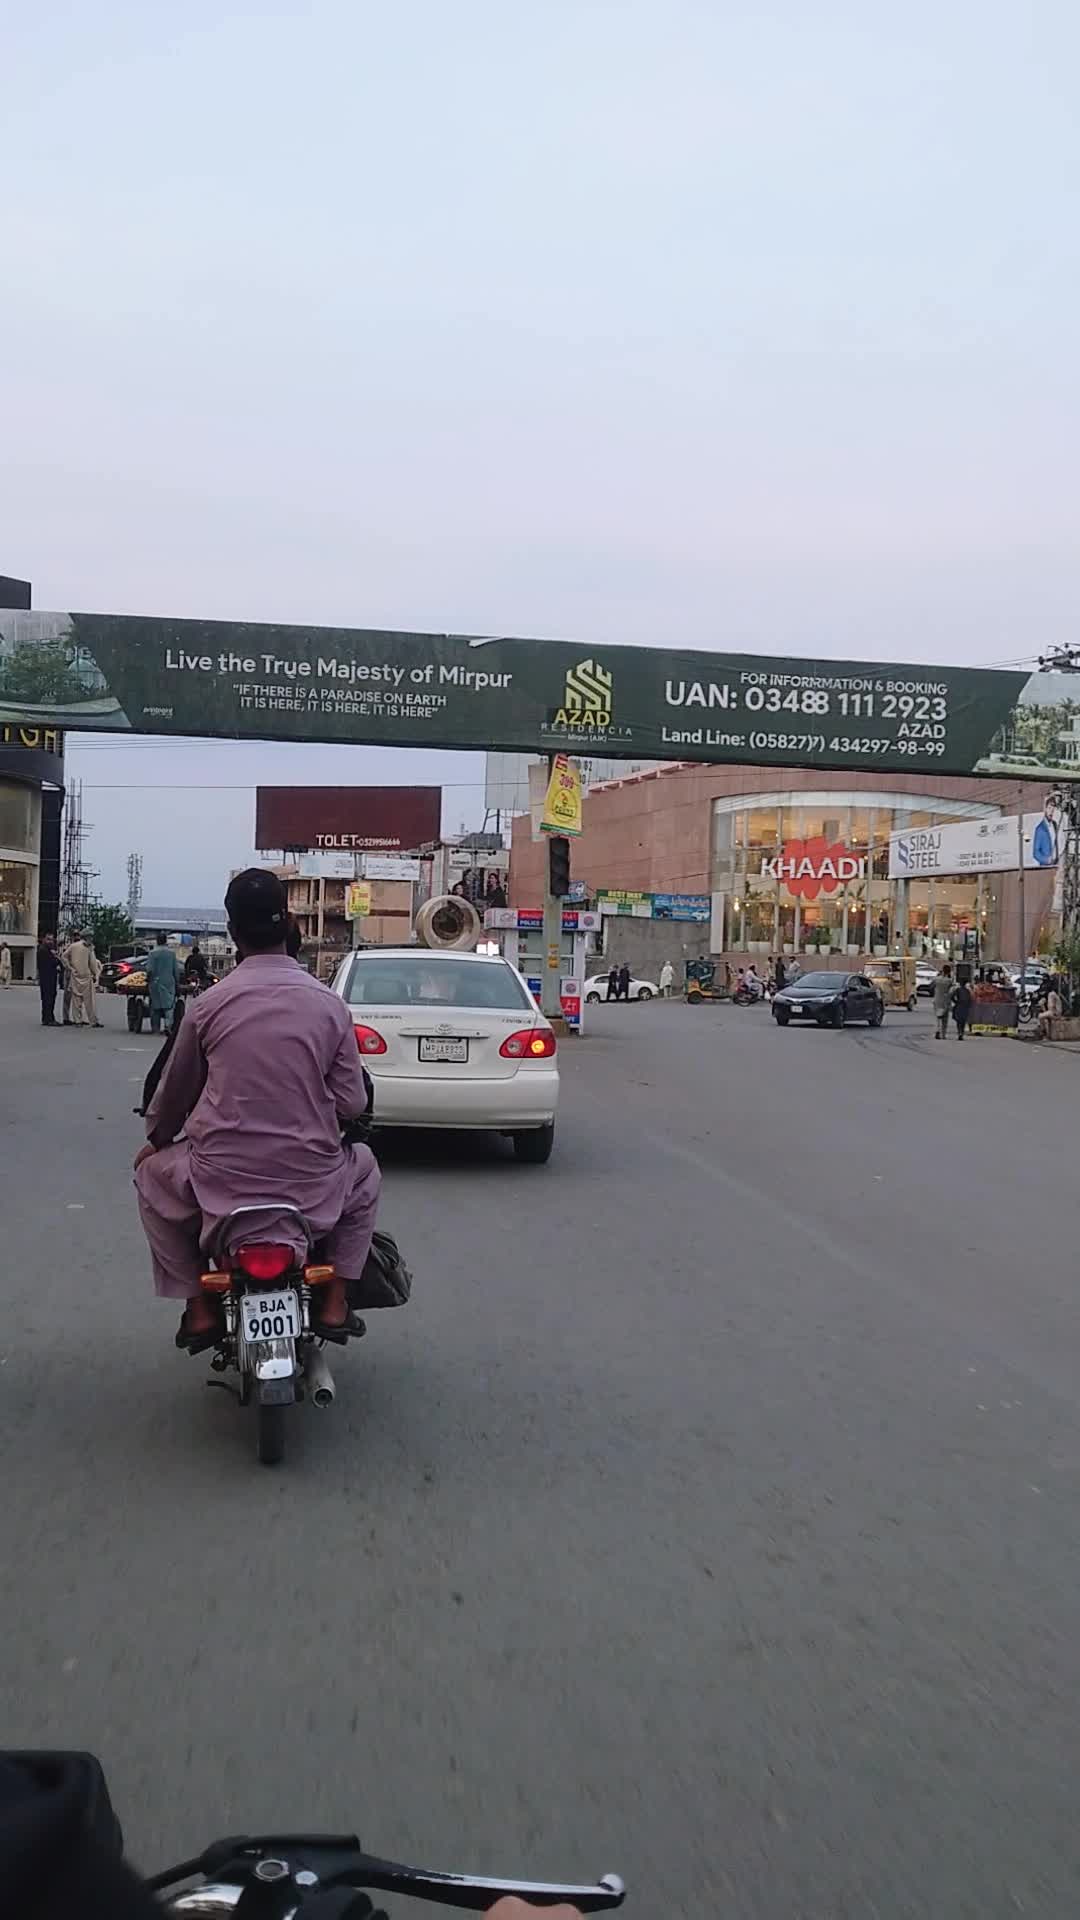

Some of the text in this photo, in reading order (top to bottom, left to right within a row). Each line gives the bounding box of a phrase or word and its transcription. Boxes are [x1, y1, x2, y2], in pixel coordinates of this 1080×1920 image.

[166, 649, 513, 691] Live the True Majesty of Mirpur
[740, 672, 767, 685] FOR
[875, 680, 884, 692] &
[886, 681, 948, 695] BOOKING
[252, 684, 292, 698] THERE
[295, 687, 306, 699] IS
[308, 687, 318, 699] A
[320, 688, 381, 703] PARADISE
[383, 692, 403, 704] ON
[405, 693, 447, 706] EARTH
[665, 680, 737, 709] UAN:
[838, 692, 874, 717] 111
[881, 694, 947, 721] 2923
[240, 696, 251, 708] IT
[254, 697, 266, 709] IS
[268, 698, 305, 711] HERE,
[307, 700, 319, 711] IT
[321, 701, 333, 713] IS
[335, 702, 370, 715] HERE,
[373, 703, 385, 715] IT
[387, 704, 398, 716] IS
[554, 708, 611, 727] AZAD
[541, 722, 632, 736] RESIDENCIA
[897, 722, 946, 739] AZAD
[662, 727, 702, 744] Land
[706, 728, 746, 746] Line:
[829, 737, 945, 756] 434297-98-99
[909, 832, 942, 852] SIRAJ
[761, 857, 865, 879] KHAADI
[909, 851, 942, 870] STEEL
[260, 1299, 286, 1313] BJA
[249, 1315, 293, 1339] 9001
